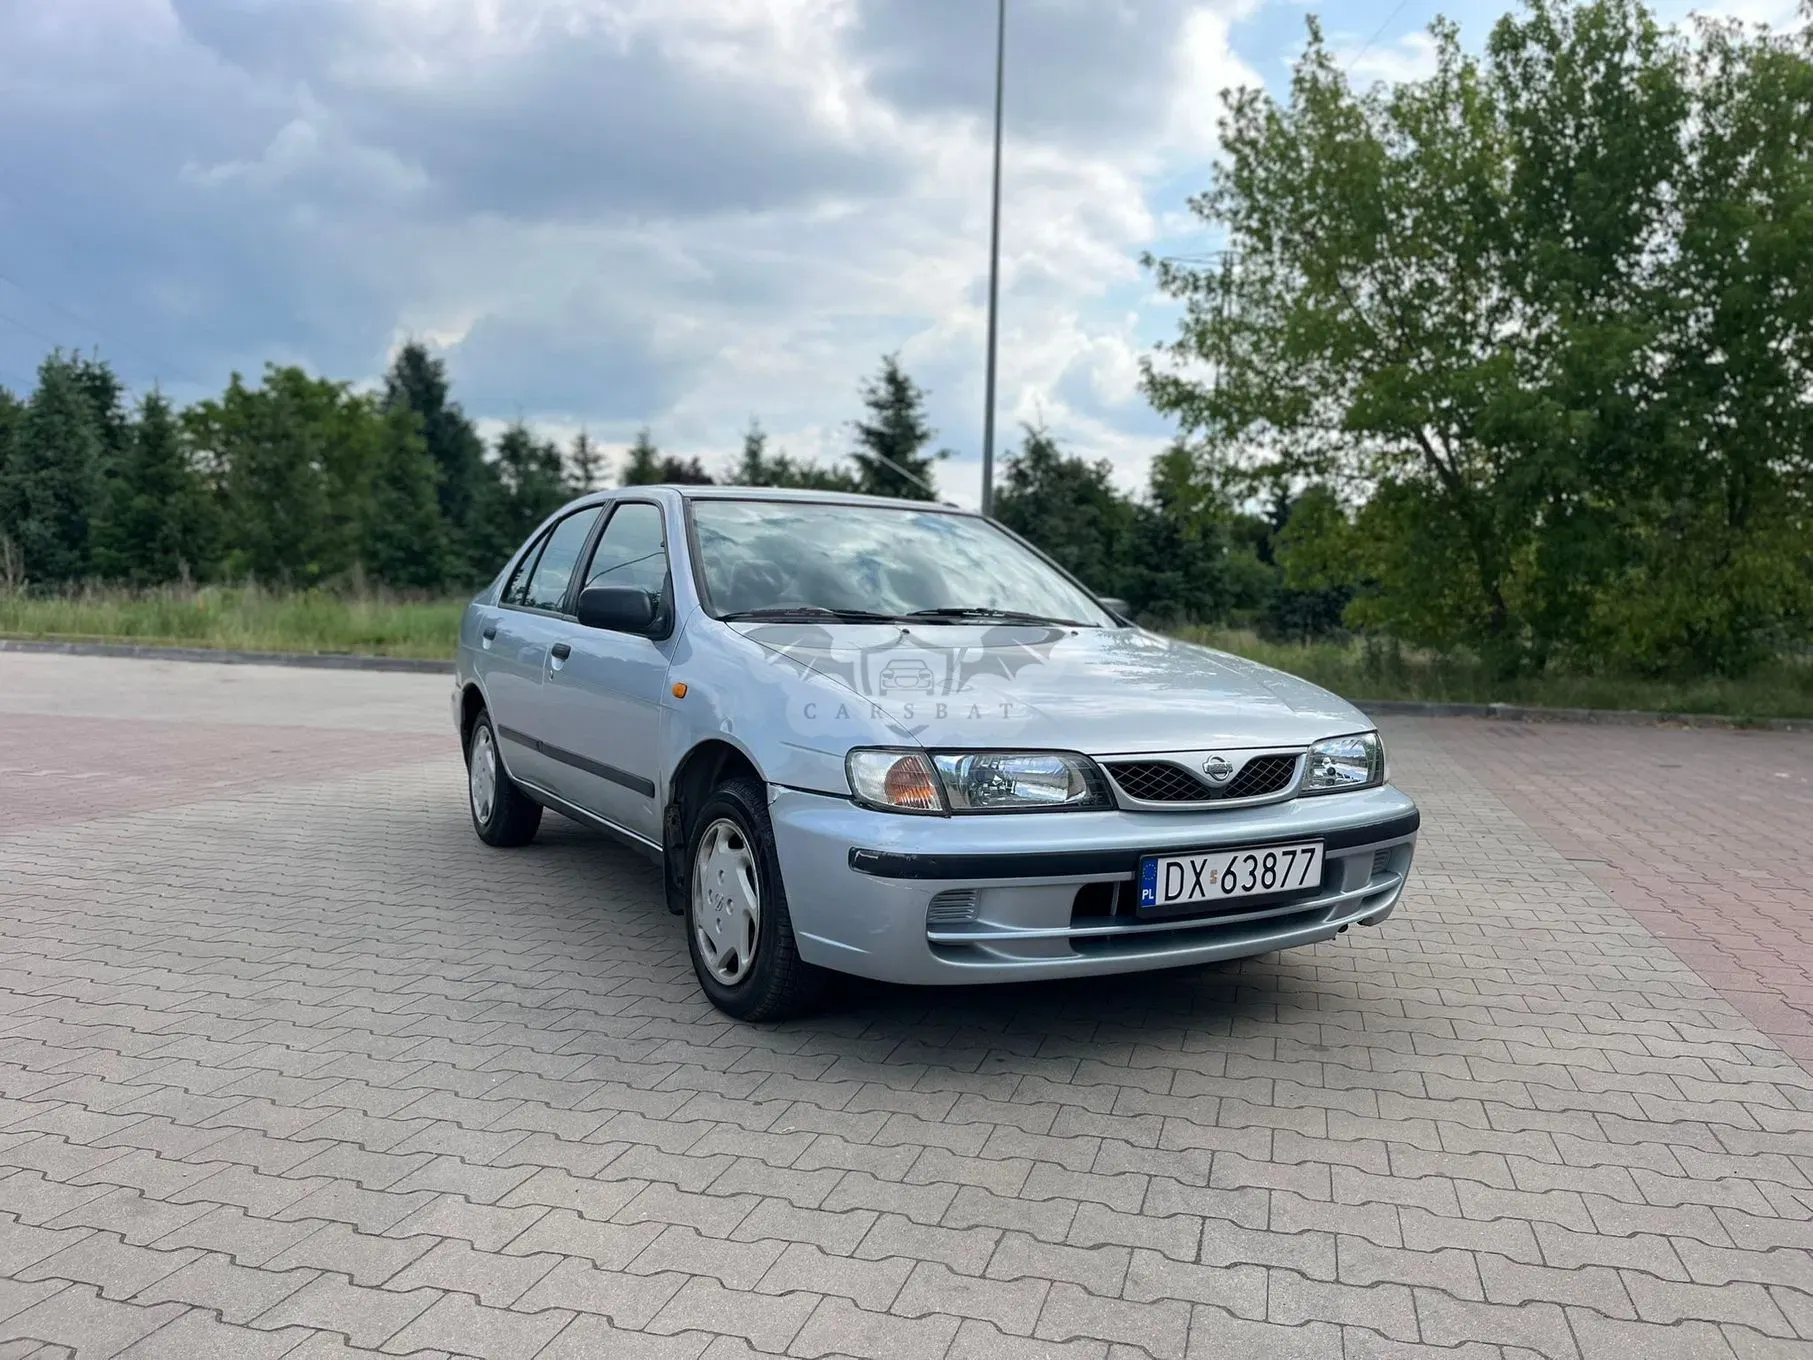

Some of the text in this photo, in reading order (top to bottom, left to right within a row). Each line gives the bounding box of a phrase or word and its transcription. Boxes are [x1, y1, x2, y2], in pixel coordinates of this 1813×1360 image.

[1164, 848, 1316, 902] DX 63877
[1141, 888, 1155, 900] PL
